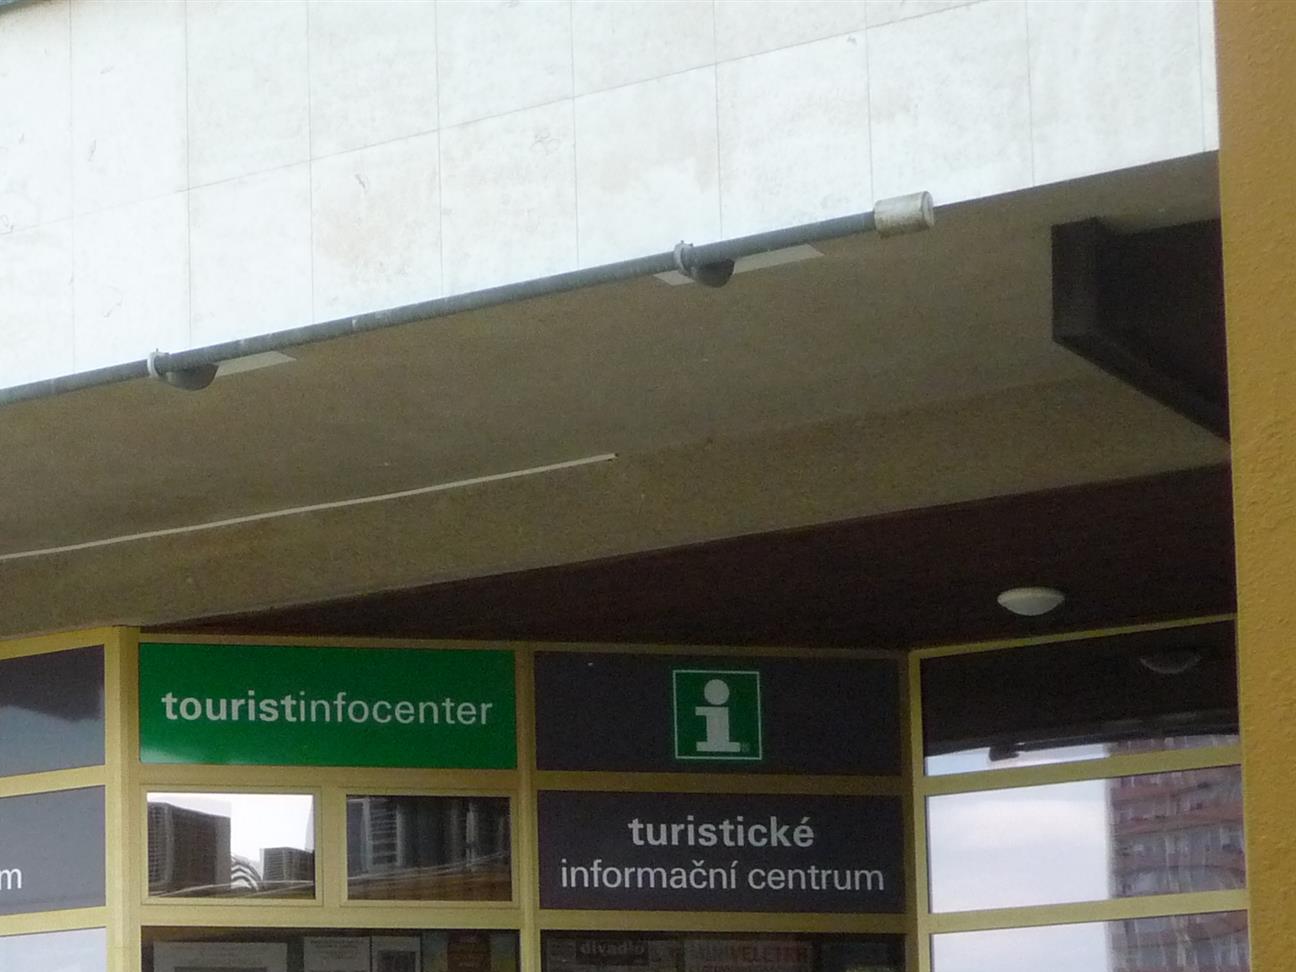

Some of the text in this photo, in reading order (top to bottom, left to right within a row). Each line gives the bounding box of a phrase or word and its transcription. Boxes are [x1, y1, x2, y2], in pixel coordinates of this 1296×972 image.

[161, 690, 493, 725] touristinfocenter
[628, 815, 815, 847] turistické
[561, 858, 885, 890] informační centrum
